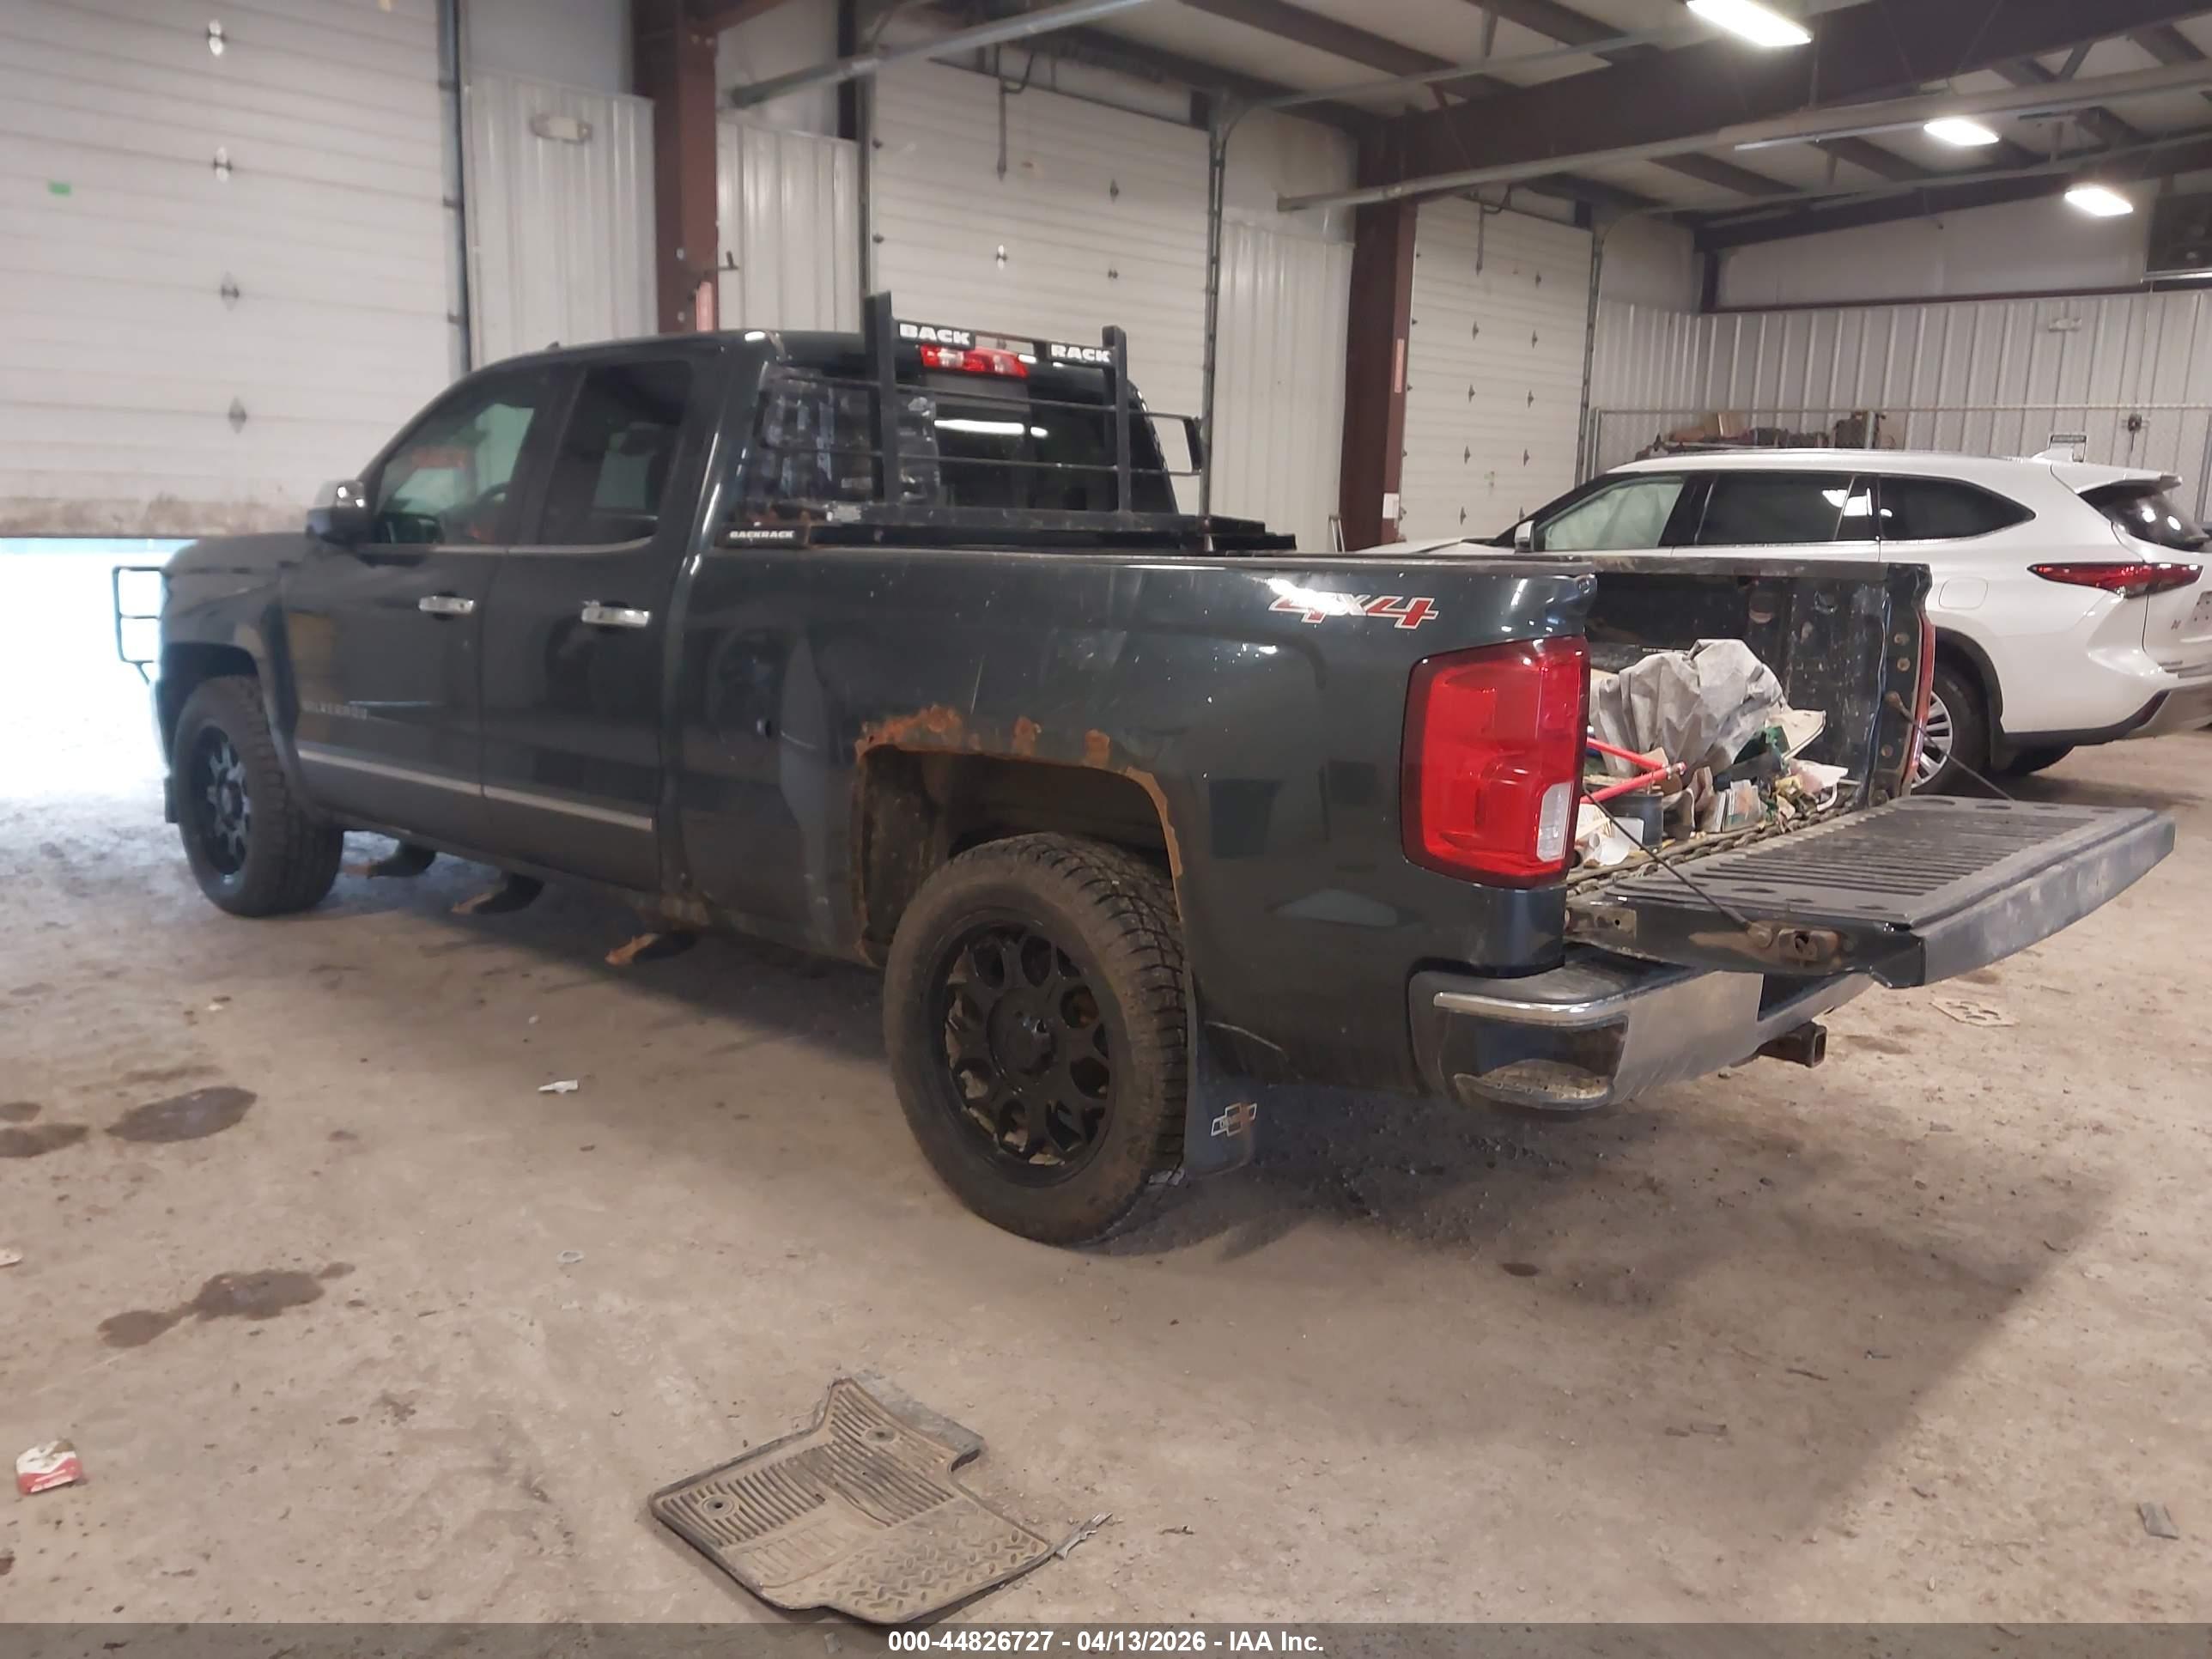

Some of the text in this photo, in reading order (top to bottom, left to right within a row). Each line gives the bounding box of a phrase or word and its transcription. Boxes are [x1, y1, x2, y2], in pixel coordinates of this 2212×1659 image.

[899, 322, 1111, 363] BACK RACK
[729, 529, 795, 539] BACKRACK
